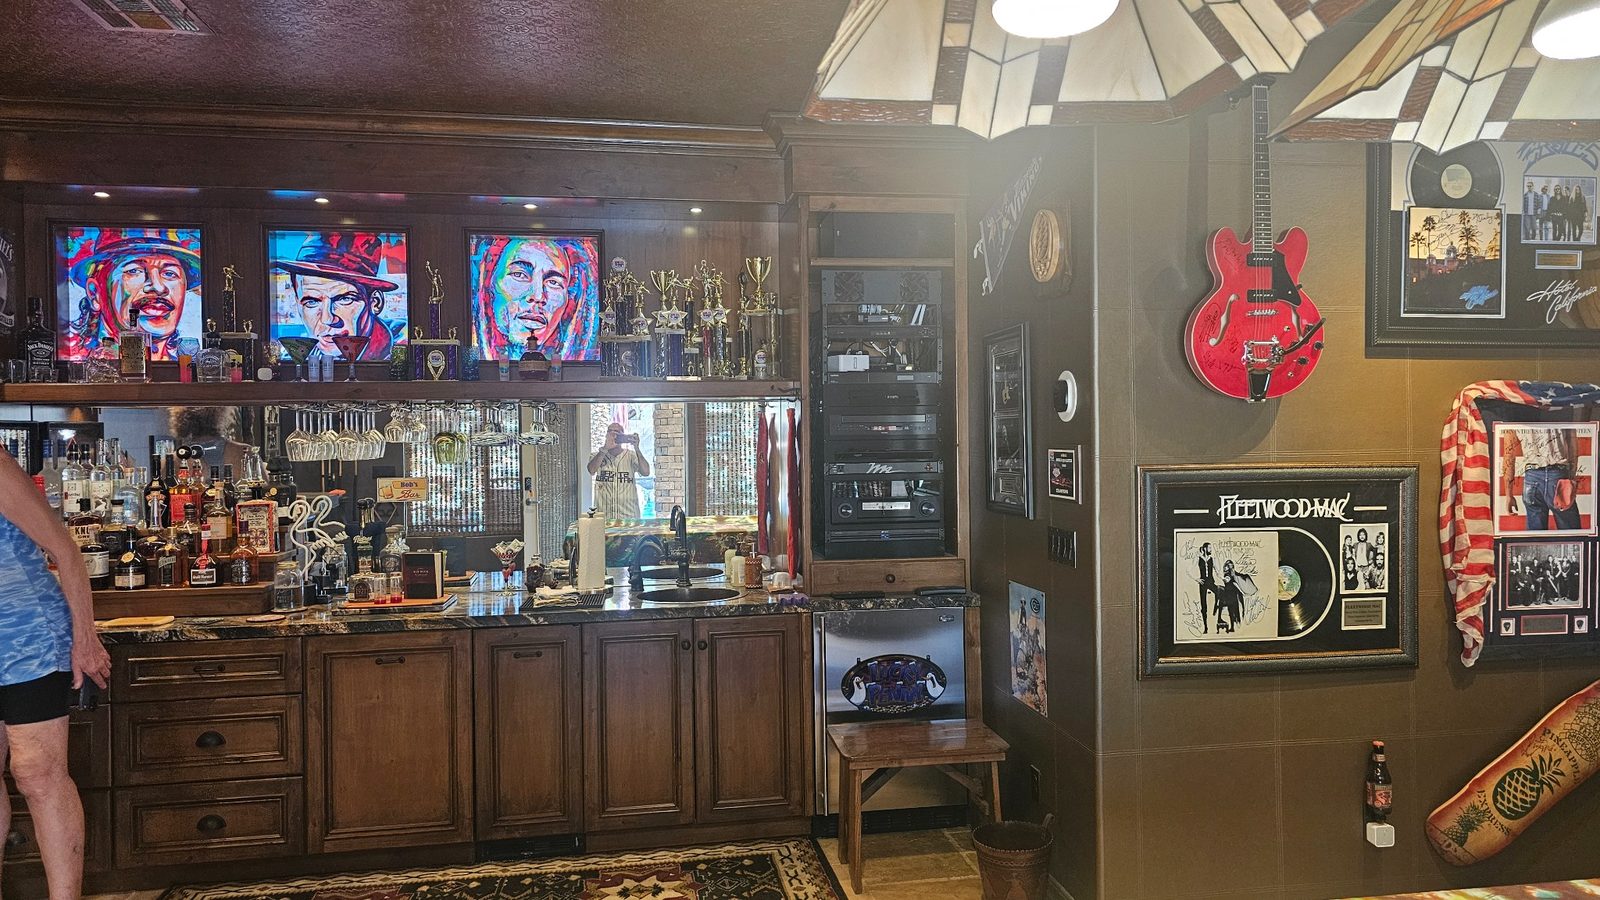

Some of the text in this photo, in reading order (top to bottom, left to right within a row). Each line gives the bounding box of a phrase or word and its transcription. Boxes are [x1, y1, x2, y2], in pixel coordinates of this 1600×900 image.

[1526, 279, 1579, 303] Hotel
[1545, 287, 1598, 325] California
[1476, 789, 1512, 837] EXPRESS
